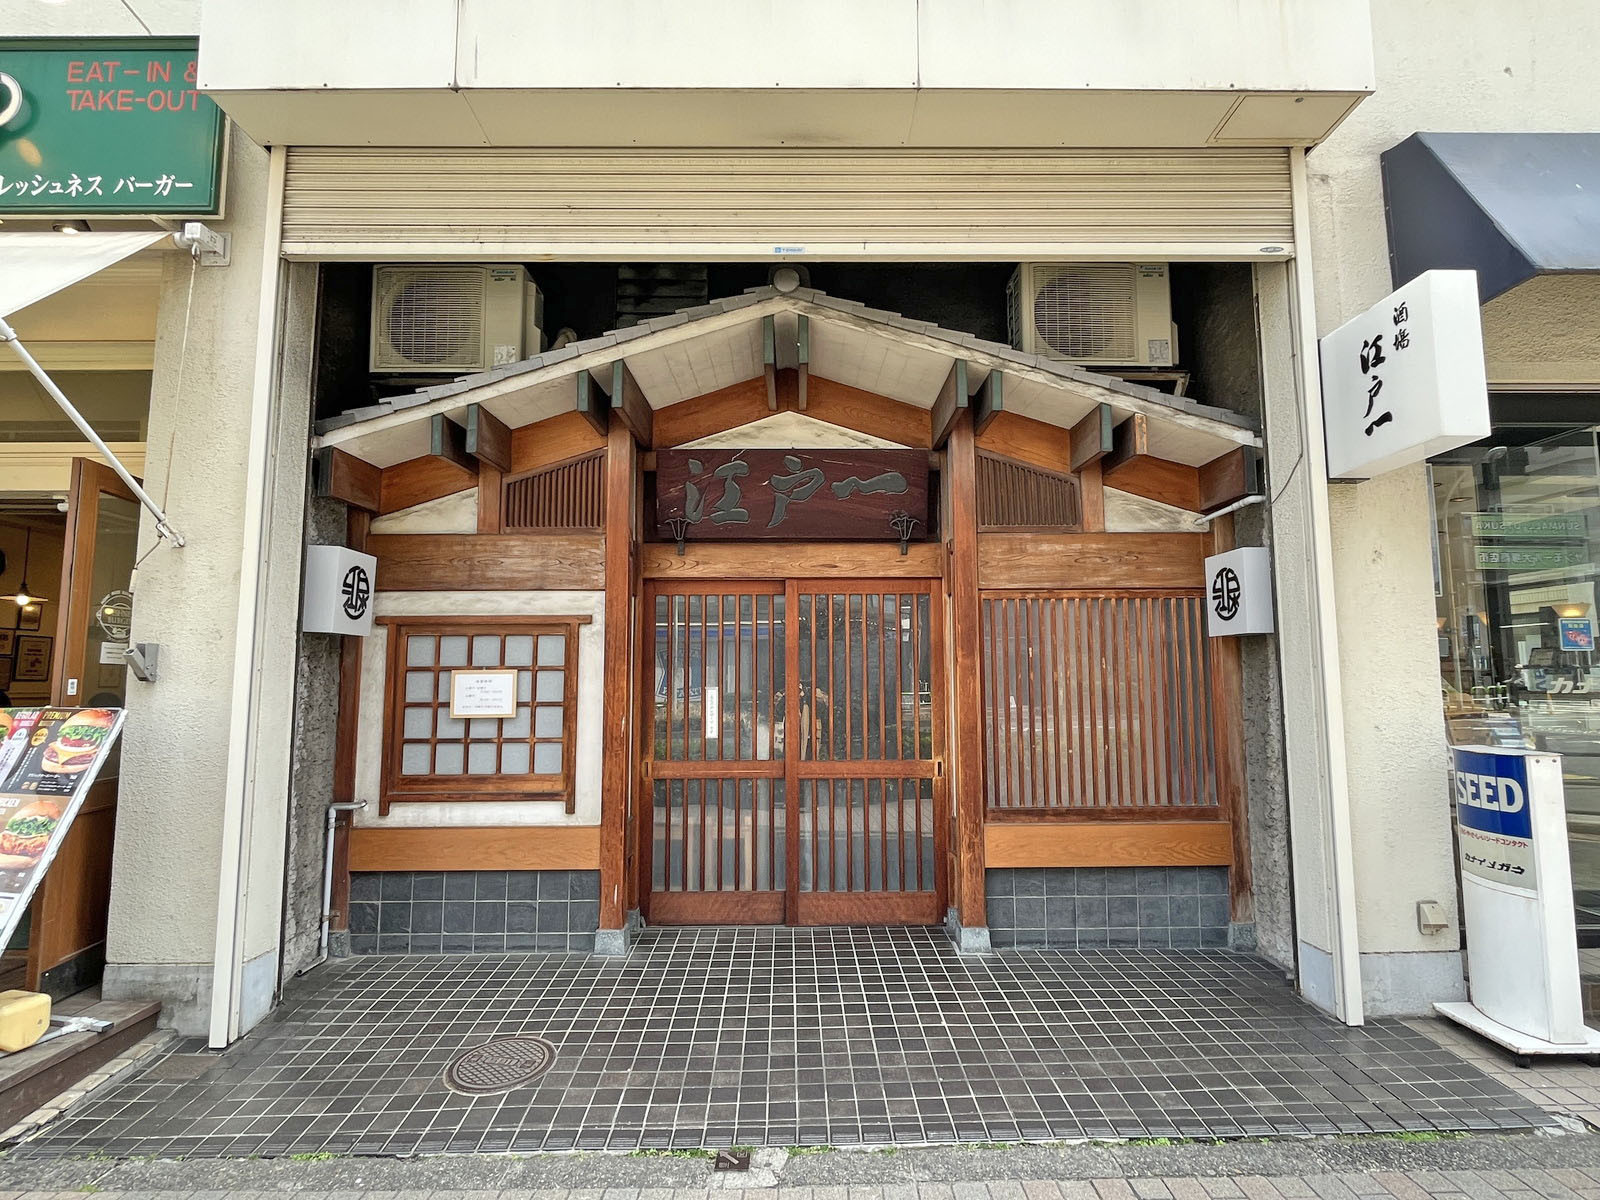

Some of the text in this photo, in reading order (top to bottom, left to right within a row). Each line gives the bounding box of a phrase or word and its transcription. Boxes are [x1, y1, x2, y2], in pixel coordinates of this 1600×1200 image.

[66, 90, 200, 112] TAKE-OUT
[113, 174, 193, 197] バーガー
[1360, 334, 1393, 436] 江戸一
[684, 455, 908, 529] 江戸一
[1457, 771, 1523, 813] SEED
